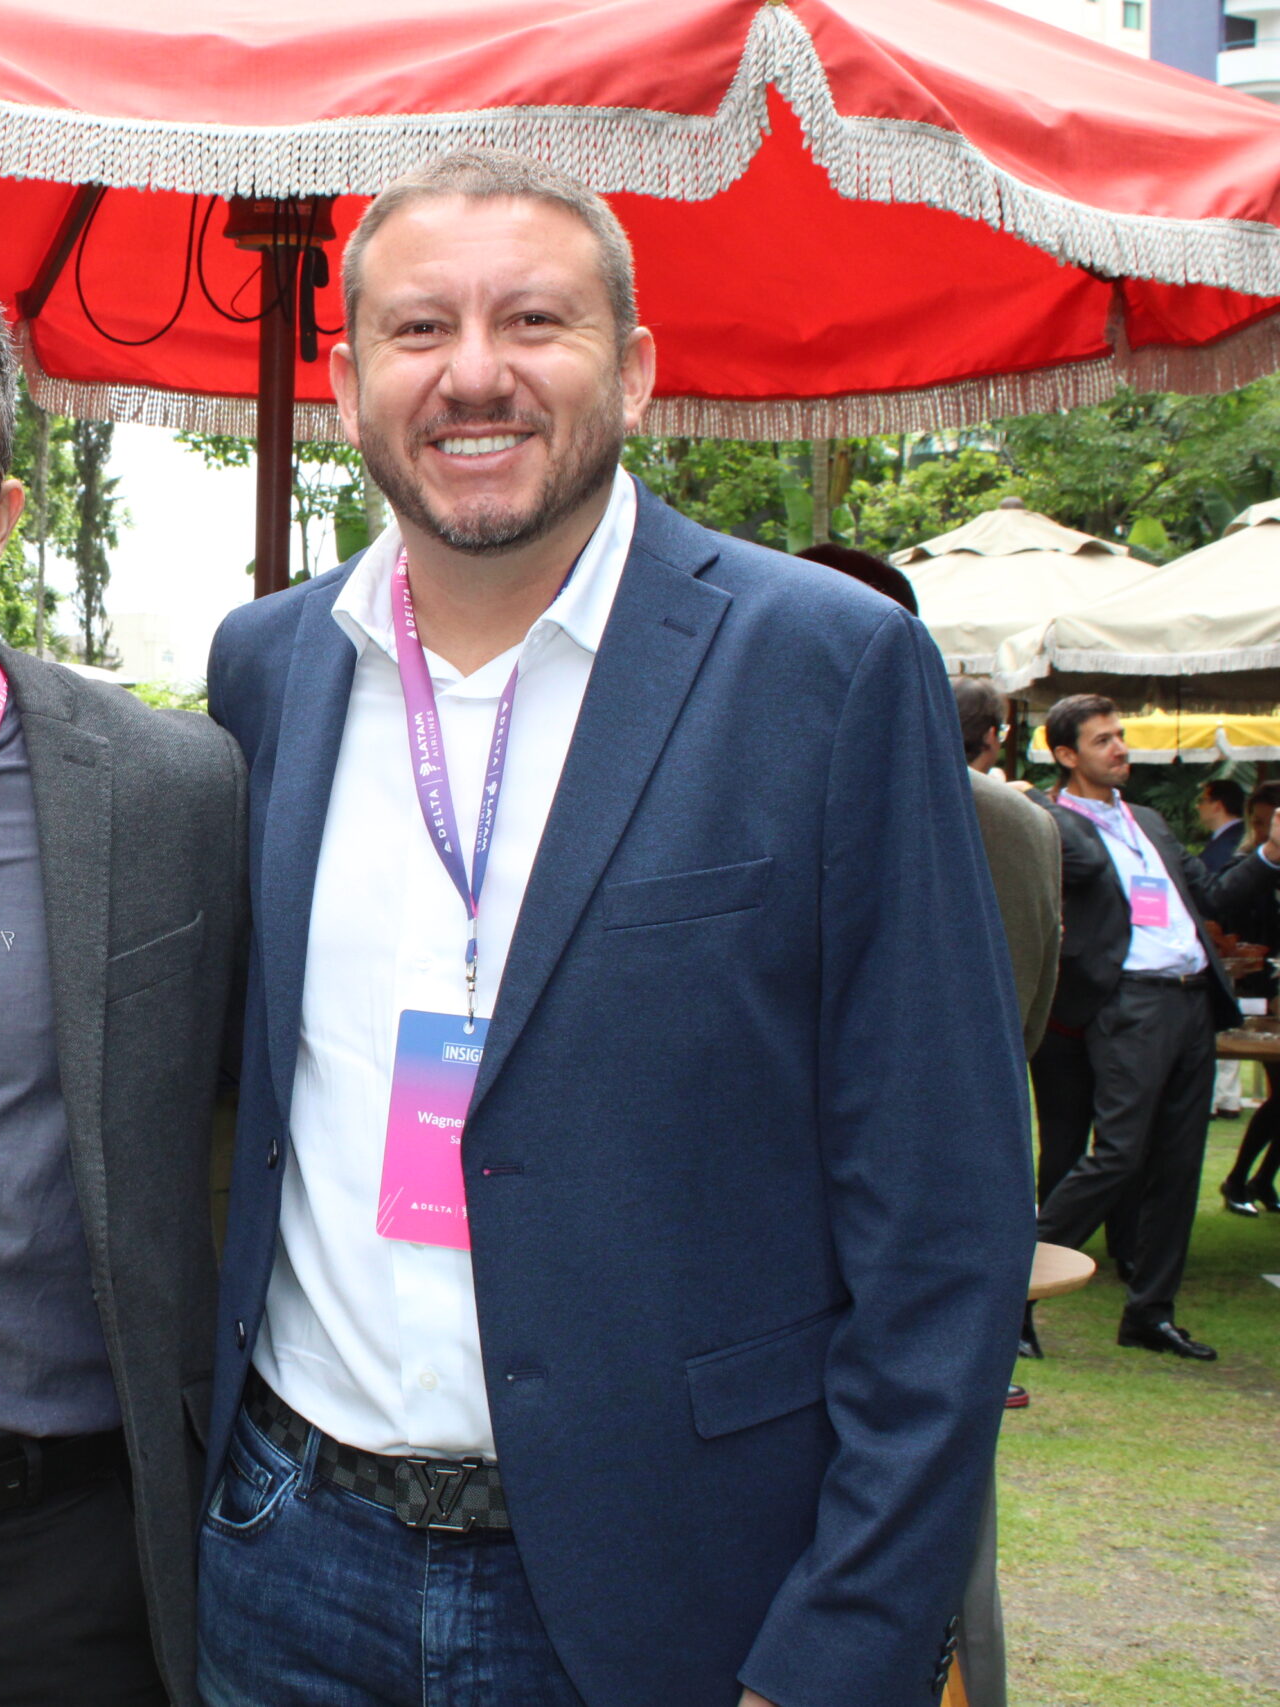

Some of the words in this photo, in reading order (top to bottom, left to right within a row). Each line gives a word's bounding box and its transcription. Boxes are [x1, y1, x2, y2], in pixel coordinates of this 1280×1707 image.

[403, 588, 415, 627] DELTA
[426, 710, 440, 758] AIRLINES
[492, 716, 506, 767] DELTA
[414, 711, 430, 761] LATAM
[428, 788, 447, 839] DELTA
[480, 799, 494, 852] LATAM
[445, 1045, 484, 1063] INSIG
[449, 1135, 462, 1145] Sa
[420, 1202, 453, 1214] DELTA
